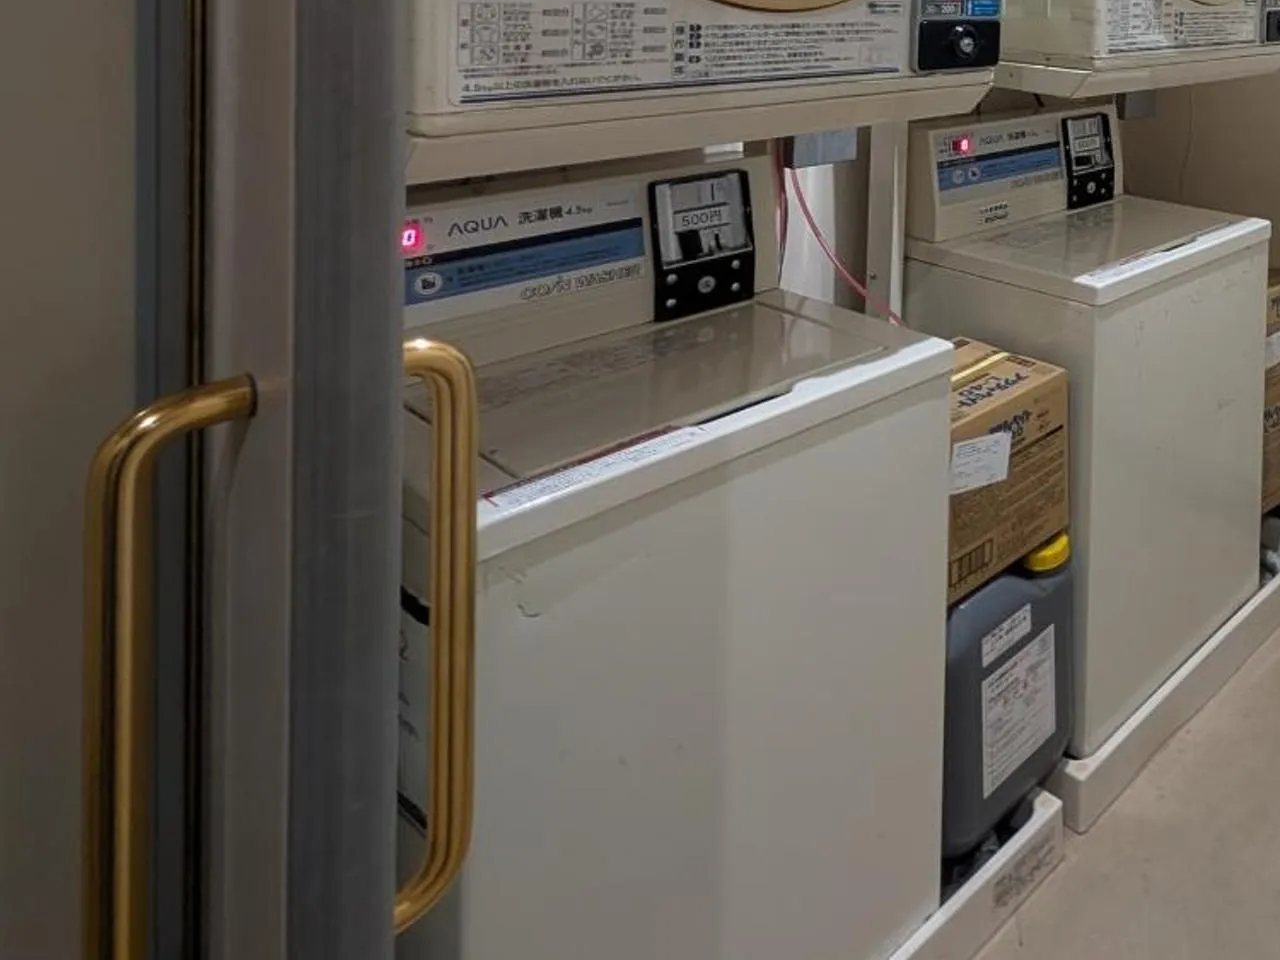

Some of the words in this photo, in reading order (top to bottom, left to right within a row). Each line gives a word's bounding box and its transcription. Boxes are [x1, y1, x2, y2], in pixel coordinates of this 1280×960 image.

[448, 215, 509, 238] AQUA
[517, 205, 564, 225] 洗濯機
[681, 209, 722, 228] 500円
